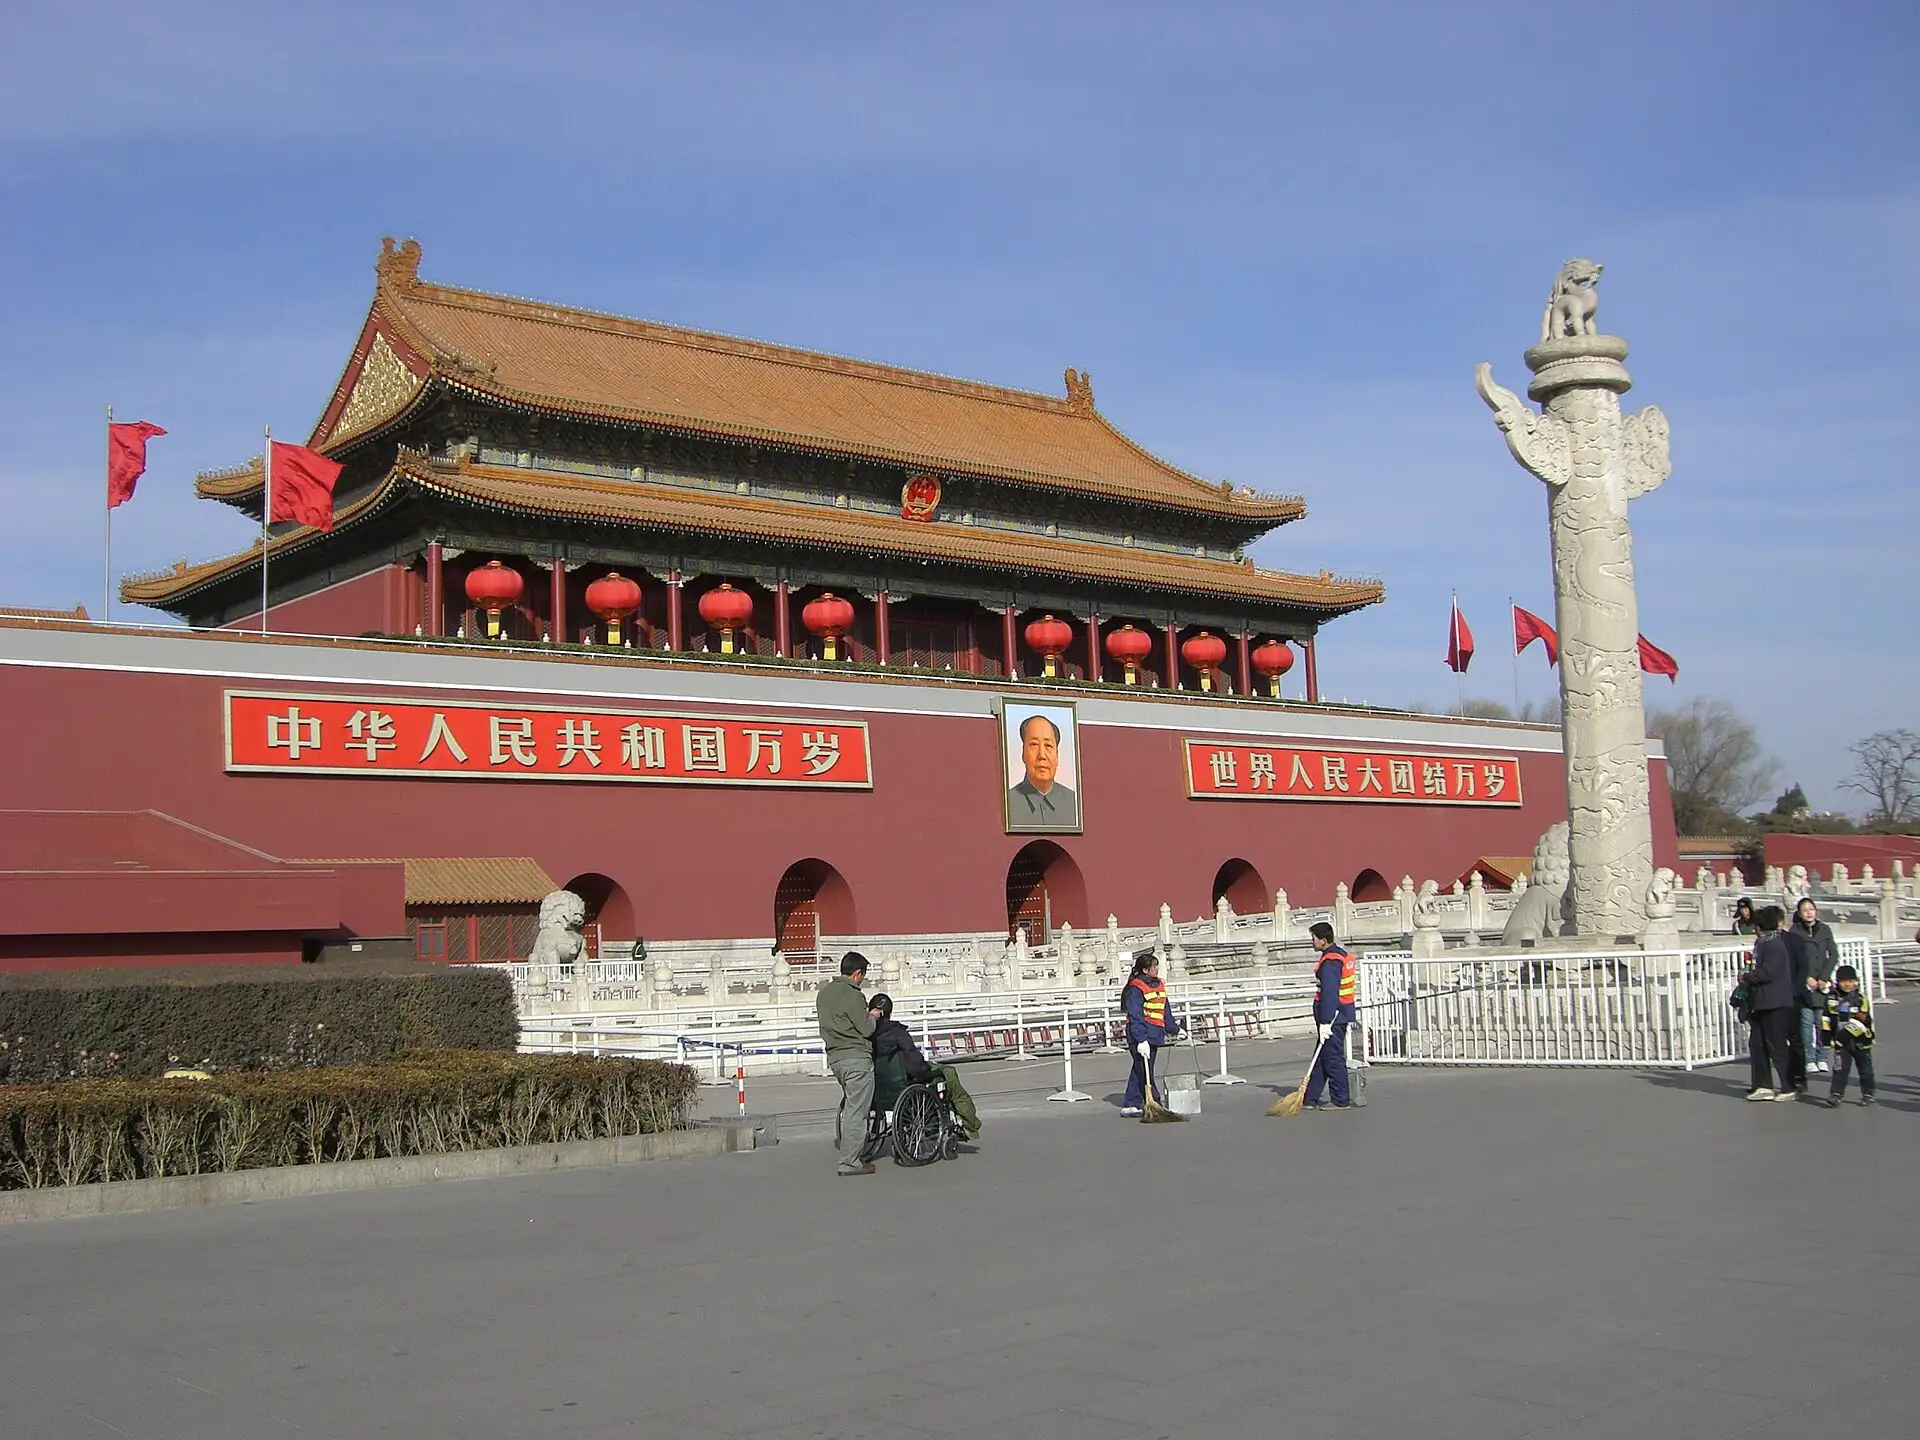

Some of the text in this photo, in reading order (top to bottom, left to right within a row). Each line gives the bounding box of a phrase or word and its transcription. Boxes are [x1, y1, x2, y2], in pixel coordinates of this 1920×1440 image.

[267, 706, 842, 776] 中华人民共和国万岁
[1209, 750, 1506, 797] 世界人民大团结万岁
